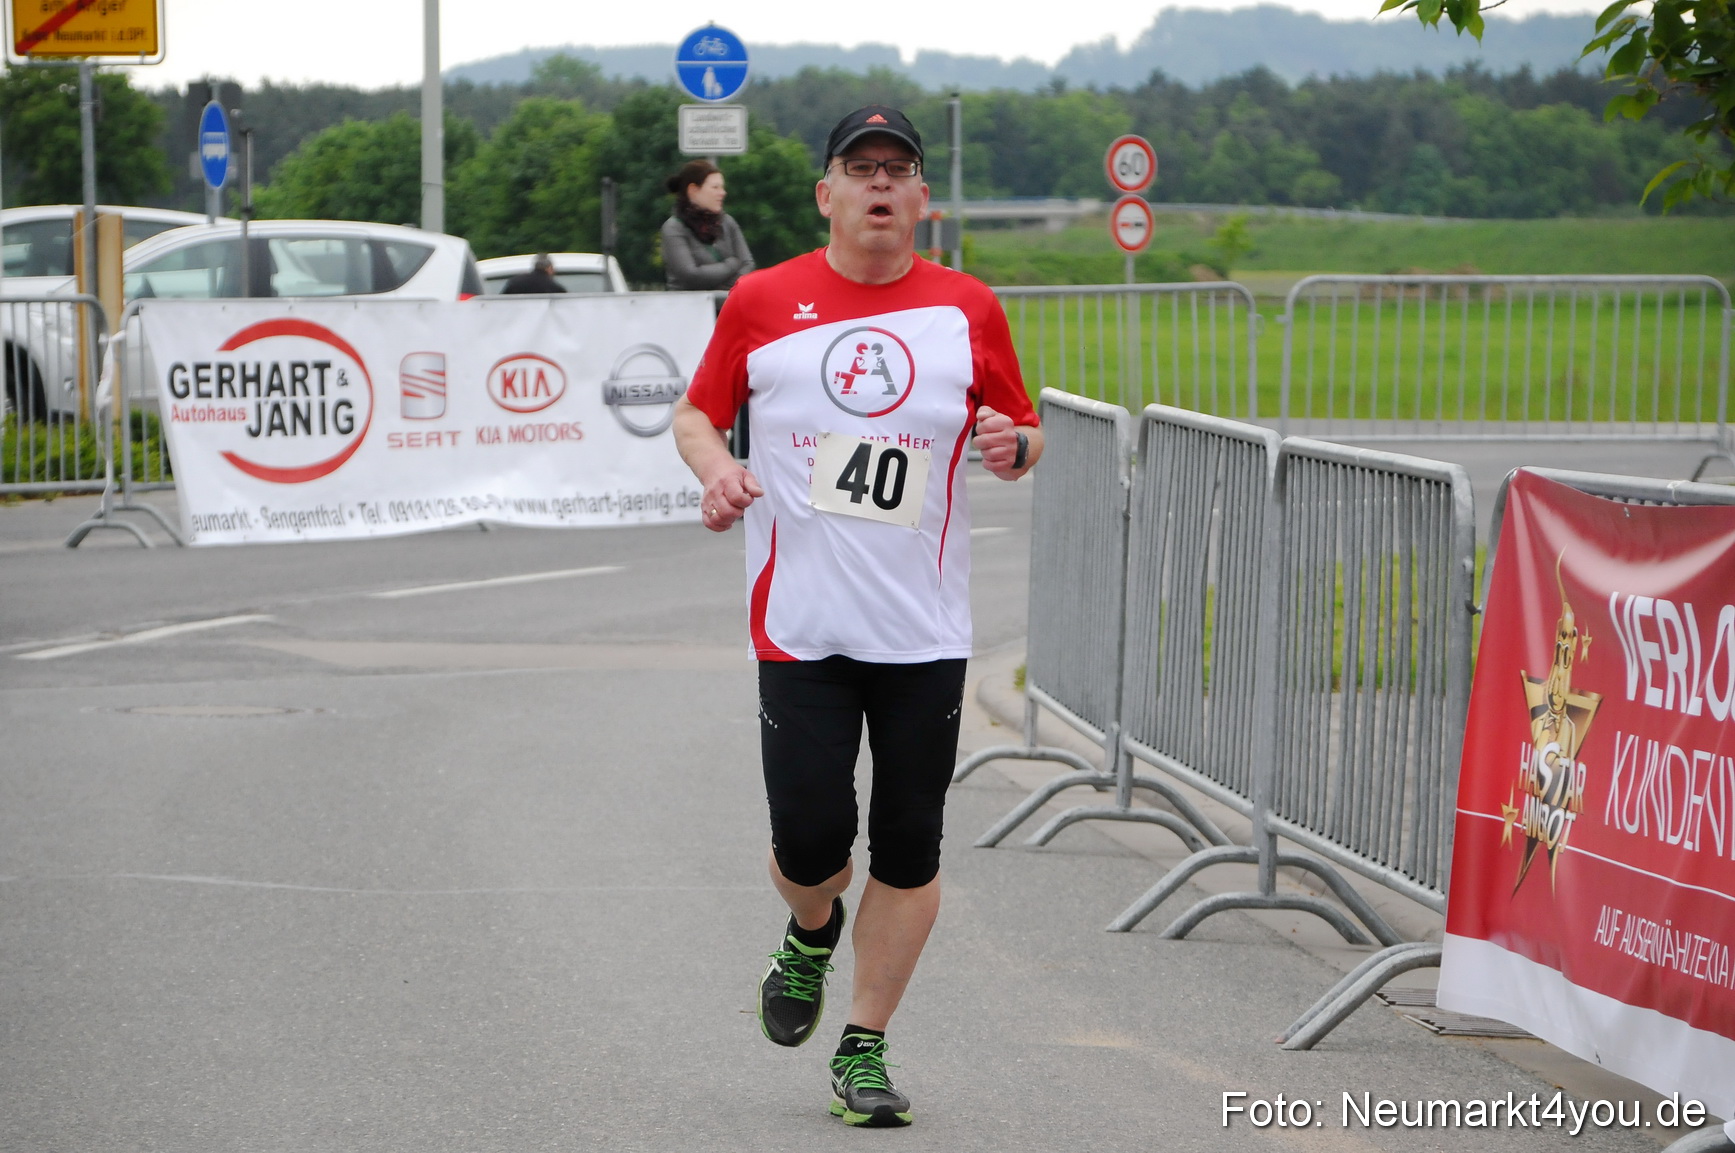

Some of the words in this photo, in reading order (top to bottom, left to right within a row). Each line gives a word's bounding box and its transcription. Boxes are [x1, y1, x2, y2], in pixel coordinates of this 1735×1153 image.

[1119, 151, 1146, 176] 60
[793, 311, 818, 320] erima
[169, 361, 331, 398] GERHART
[337, 369, 348, 387] &
[500, 367, 553, 398] KIA
[610, 382, 681, 400] NISSAN
[171, 403, 247, 423] Autohaus
[246, 399, 354, 437] JÄNIG
[386, 429, 461, 448] SEAT
[475, 426, 502, 445] KIA
[508, 421, 585, 444] MOTORS
[836, 442, 908, 510] 40
[260, 503, 346, 534] Sengenthal
[357, 502, 386, 526] Tel.
[1609, 591, 1735, 722] VERLO
[1605, 730, 1735, 861] KUNDEN
[1594, 904, 1623, 948] AUF
[1704, 941, 1729, 988] KIA
